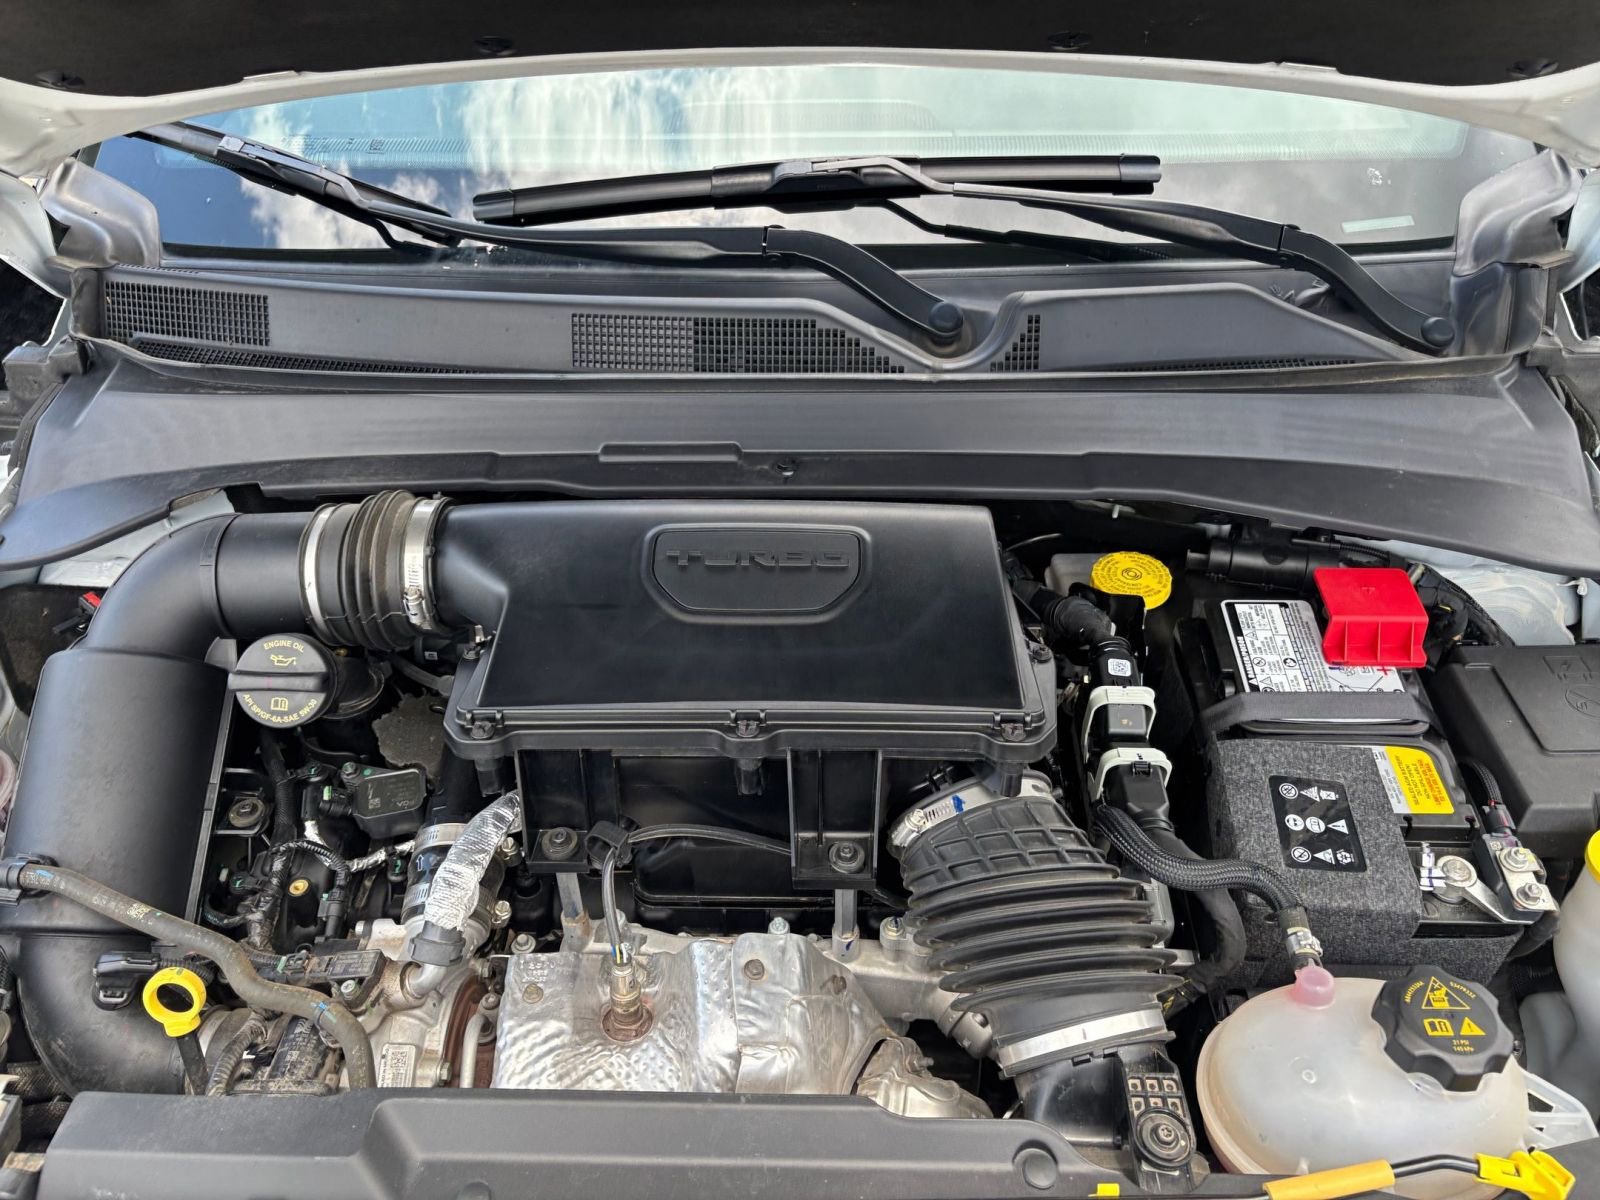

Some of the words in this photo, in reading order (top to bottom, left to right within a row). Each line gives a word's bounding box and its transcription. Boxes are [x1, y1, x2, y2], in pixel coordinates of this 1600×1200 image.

[666, 550, 850, 568] TURBO
[263, 640, 292, 650] ENGINE
[292, 643, 305, 653] OIL
[243, 693, 253, 706] API
[299, 698, 317, 717] 5W-30
